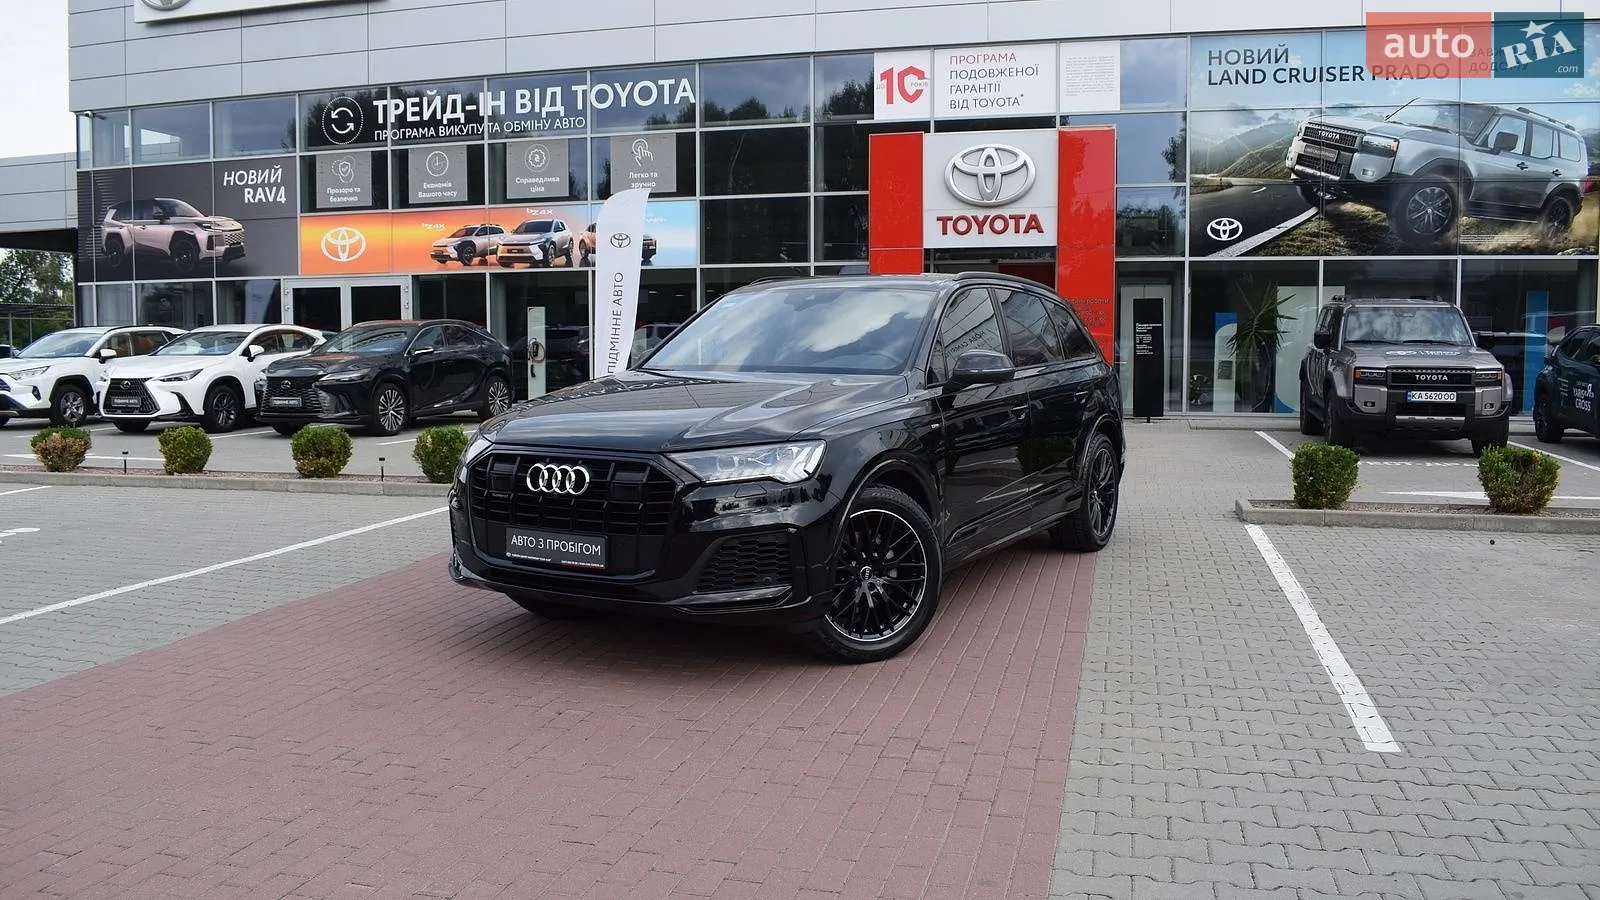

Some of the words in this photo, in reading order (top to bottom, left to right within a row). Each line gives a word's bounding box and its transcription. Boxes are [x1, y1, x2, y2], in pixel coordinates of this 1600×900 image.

[950, 53, 1017, 65] ПРОГРАМА
[1208, 43, 1289, 66] НОВИЙ
[950, 64, 1040, 81] ПОДОВЖЕНОЇ
[1208, 68, 1267, 86] LAND
[1273, 65, 1364, 84] CRUISER
[1372, 63, 1450, 81] PRADO
[950, 81, 1002, 95] ГАРАНТІЇ
[373, 90, 505, 124] ТРЕЙД-ІН
[516, 86, 565, 118] ВІД
[571, 78, 696, 110] TOYOTA
[950, 99, 969, 110] ВІД
[374, 127, 436, 141] ПРОГРАМА
[439, 123, 485, 137] ВИКУПУ
[488, 121, 501, 134] ТА
[504, 119, 551, 132] ОБМІНУ
[553, 116, 586, 129] АВТО
[223, 164, 283, 186] НОВИЙ
[244, 185, 287, 204] RAV4
[936, 213, 1044, 236] TOYOTA
[612, 272, 622, 306] АВТО
[511, 534, 536, 548] АВТО
[538, 538, 545, 550] З
[547, 539, 602, 556] ПРОБІГОМ
